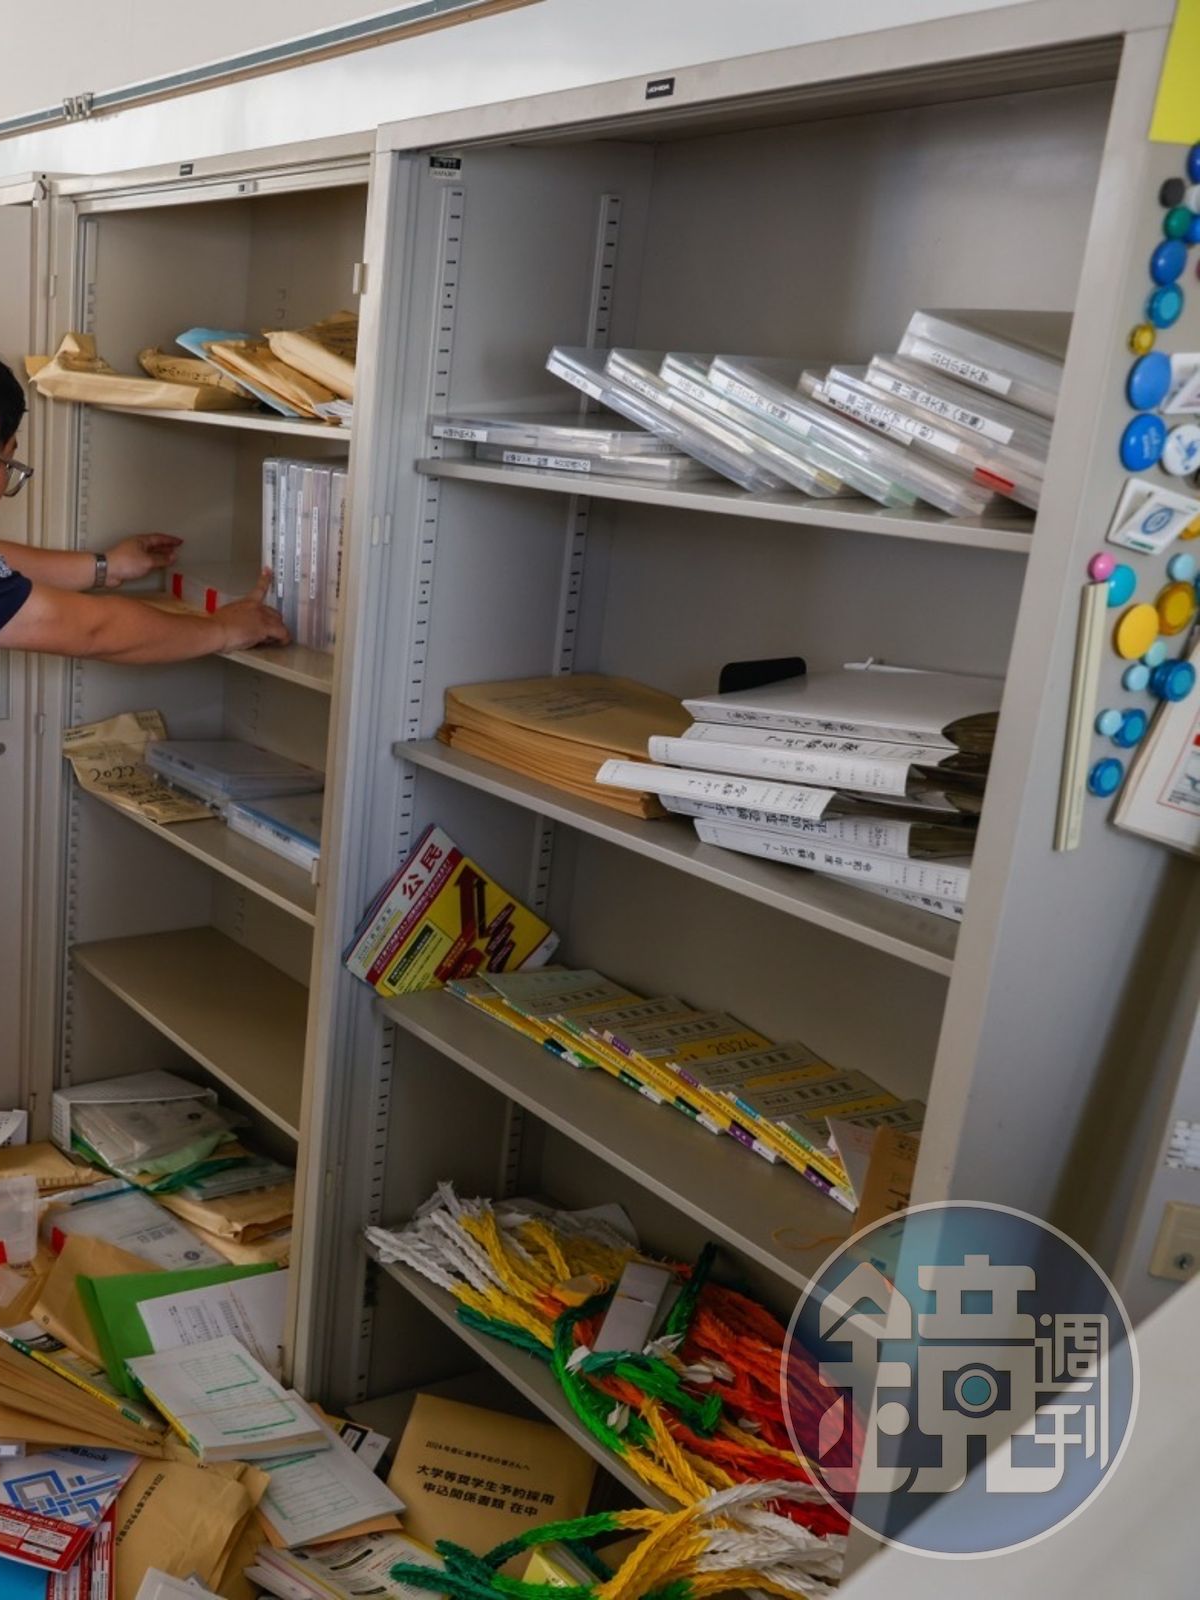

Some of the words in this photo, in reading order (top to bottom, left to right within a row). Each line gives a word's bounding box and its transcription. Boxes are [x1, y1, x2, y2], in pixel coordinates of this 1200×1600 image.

[402, 843, 443, 900] 公民
[707, 1039, 758, 1056] 2024
[416, 1464, 556, 1506] 大学等奨学生予約採用
[423, 1482, 506, 1511] 申込関係書類
[510, 1502, 539, 1518] 在中
